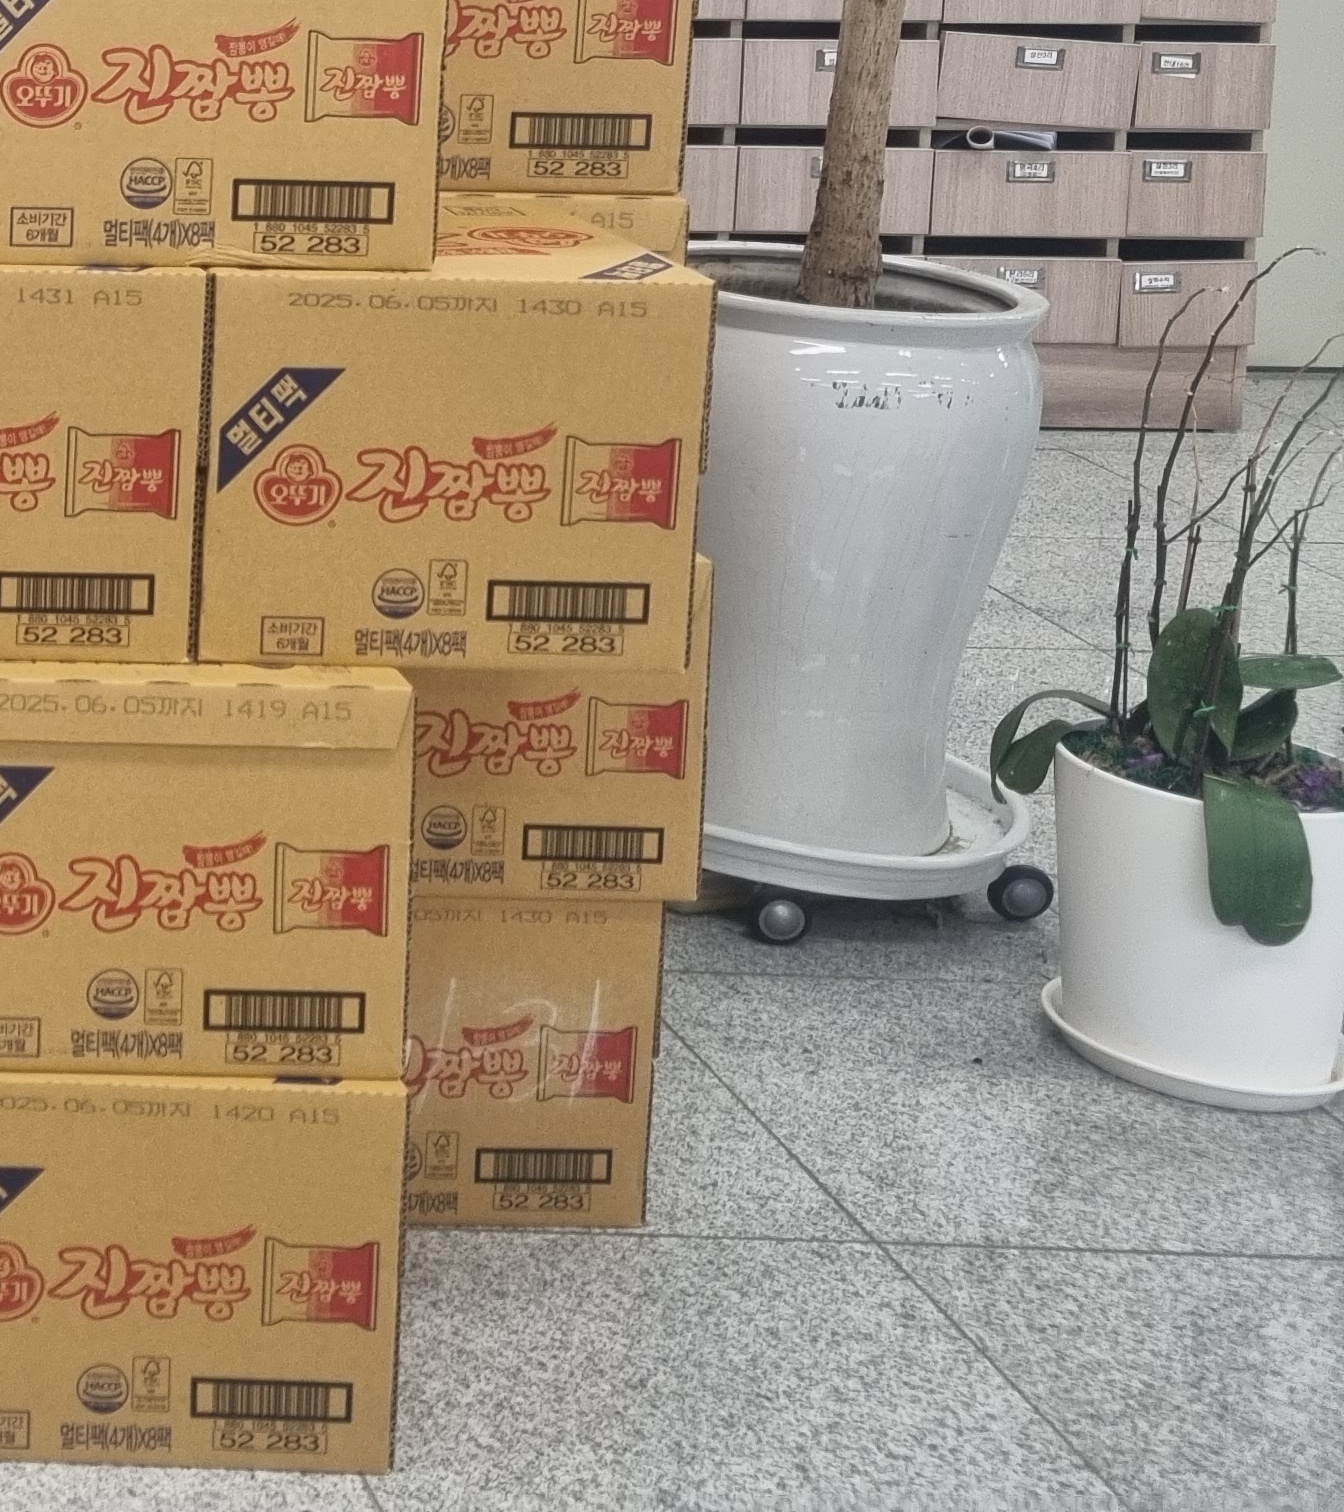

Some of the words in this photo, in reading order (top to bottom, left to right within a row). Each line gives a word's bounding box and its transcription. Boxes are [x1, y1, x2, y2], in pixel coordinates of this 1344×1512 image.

[587, 12, 662, 43] 진짬뽕
[91, 43, 298, 124] 진짬뽕
[318, 66, 407, 102] 진짬뽕
[15, 85, 73, 109] 오뚜기
[127, 174, 165, 186] HACCP
[17, 210, 68, 226] 소비기간
[25, 227, 60, 241] 6개월
[17, 287, 74, 306] 1431
[519, 298, 581, 316] 1430
[227, 373, 308, 457] 멀티팩
[268, 483, 328, 507] 오뚜기
[345, 445, 555, 525] 진짬뽕
[224, 699, 286, 719] 1419
[57, 855, 265, 933] 진짬뽕
[48, 1242, 251, 1322] 진짬뽕
